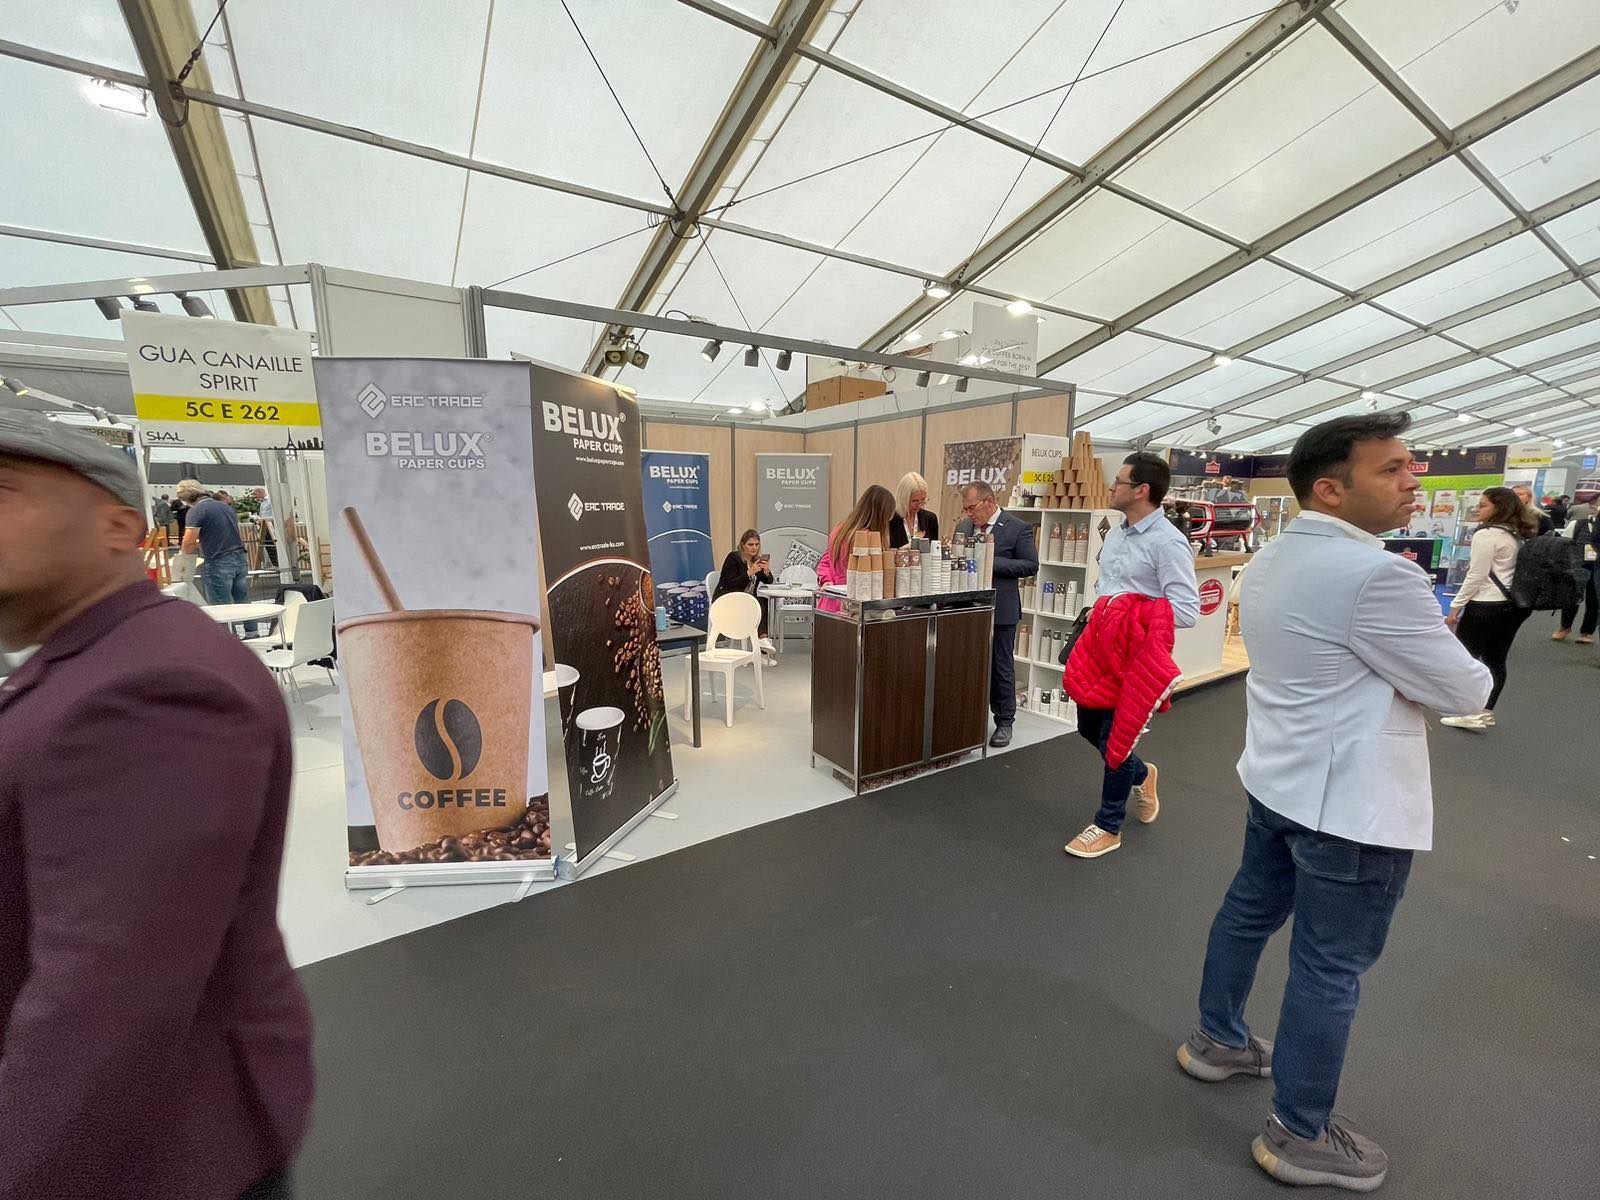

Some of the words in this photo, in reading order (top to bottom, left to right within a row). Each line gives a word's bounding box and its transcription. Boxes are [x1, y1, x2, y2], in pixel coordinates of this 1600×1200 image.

[139, 344, 197, 366] GUA
[202, 350, 303, 373] CANAILLE
[199, 373, 258, 392] SPIRIT
[428, 396, 483, 407] TRADE
[186, 401, 215, 419] 5C
[221, 403, 234, 419] E
[239, 404, 280, 421] 262
[146, 431, 185, 442] SIAL
[366, 432, 485, 457] BELUX
[573, 438, 602, 452] PAPER
[603, 442, 624, 455] CUPS
[1031, 448, 1047, 457] BELUX
[1048, 450, 1062, 458] CUPS
[399, 459, 445, 469] PAPER
[447, 459, 485, 469] CUPS
[649, 465, 698, 479] BELUX
[766, 468, 816, 480] BELUX
[947, 467, 1008, 485] BELUX
[992, 484, 1007, 492] UPS
[601, 502, 626, 511] TRADE
[398, 788, 507, 811] COFFEE
